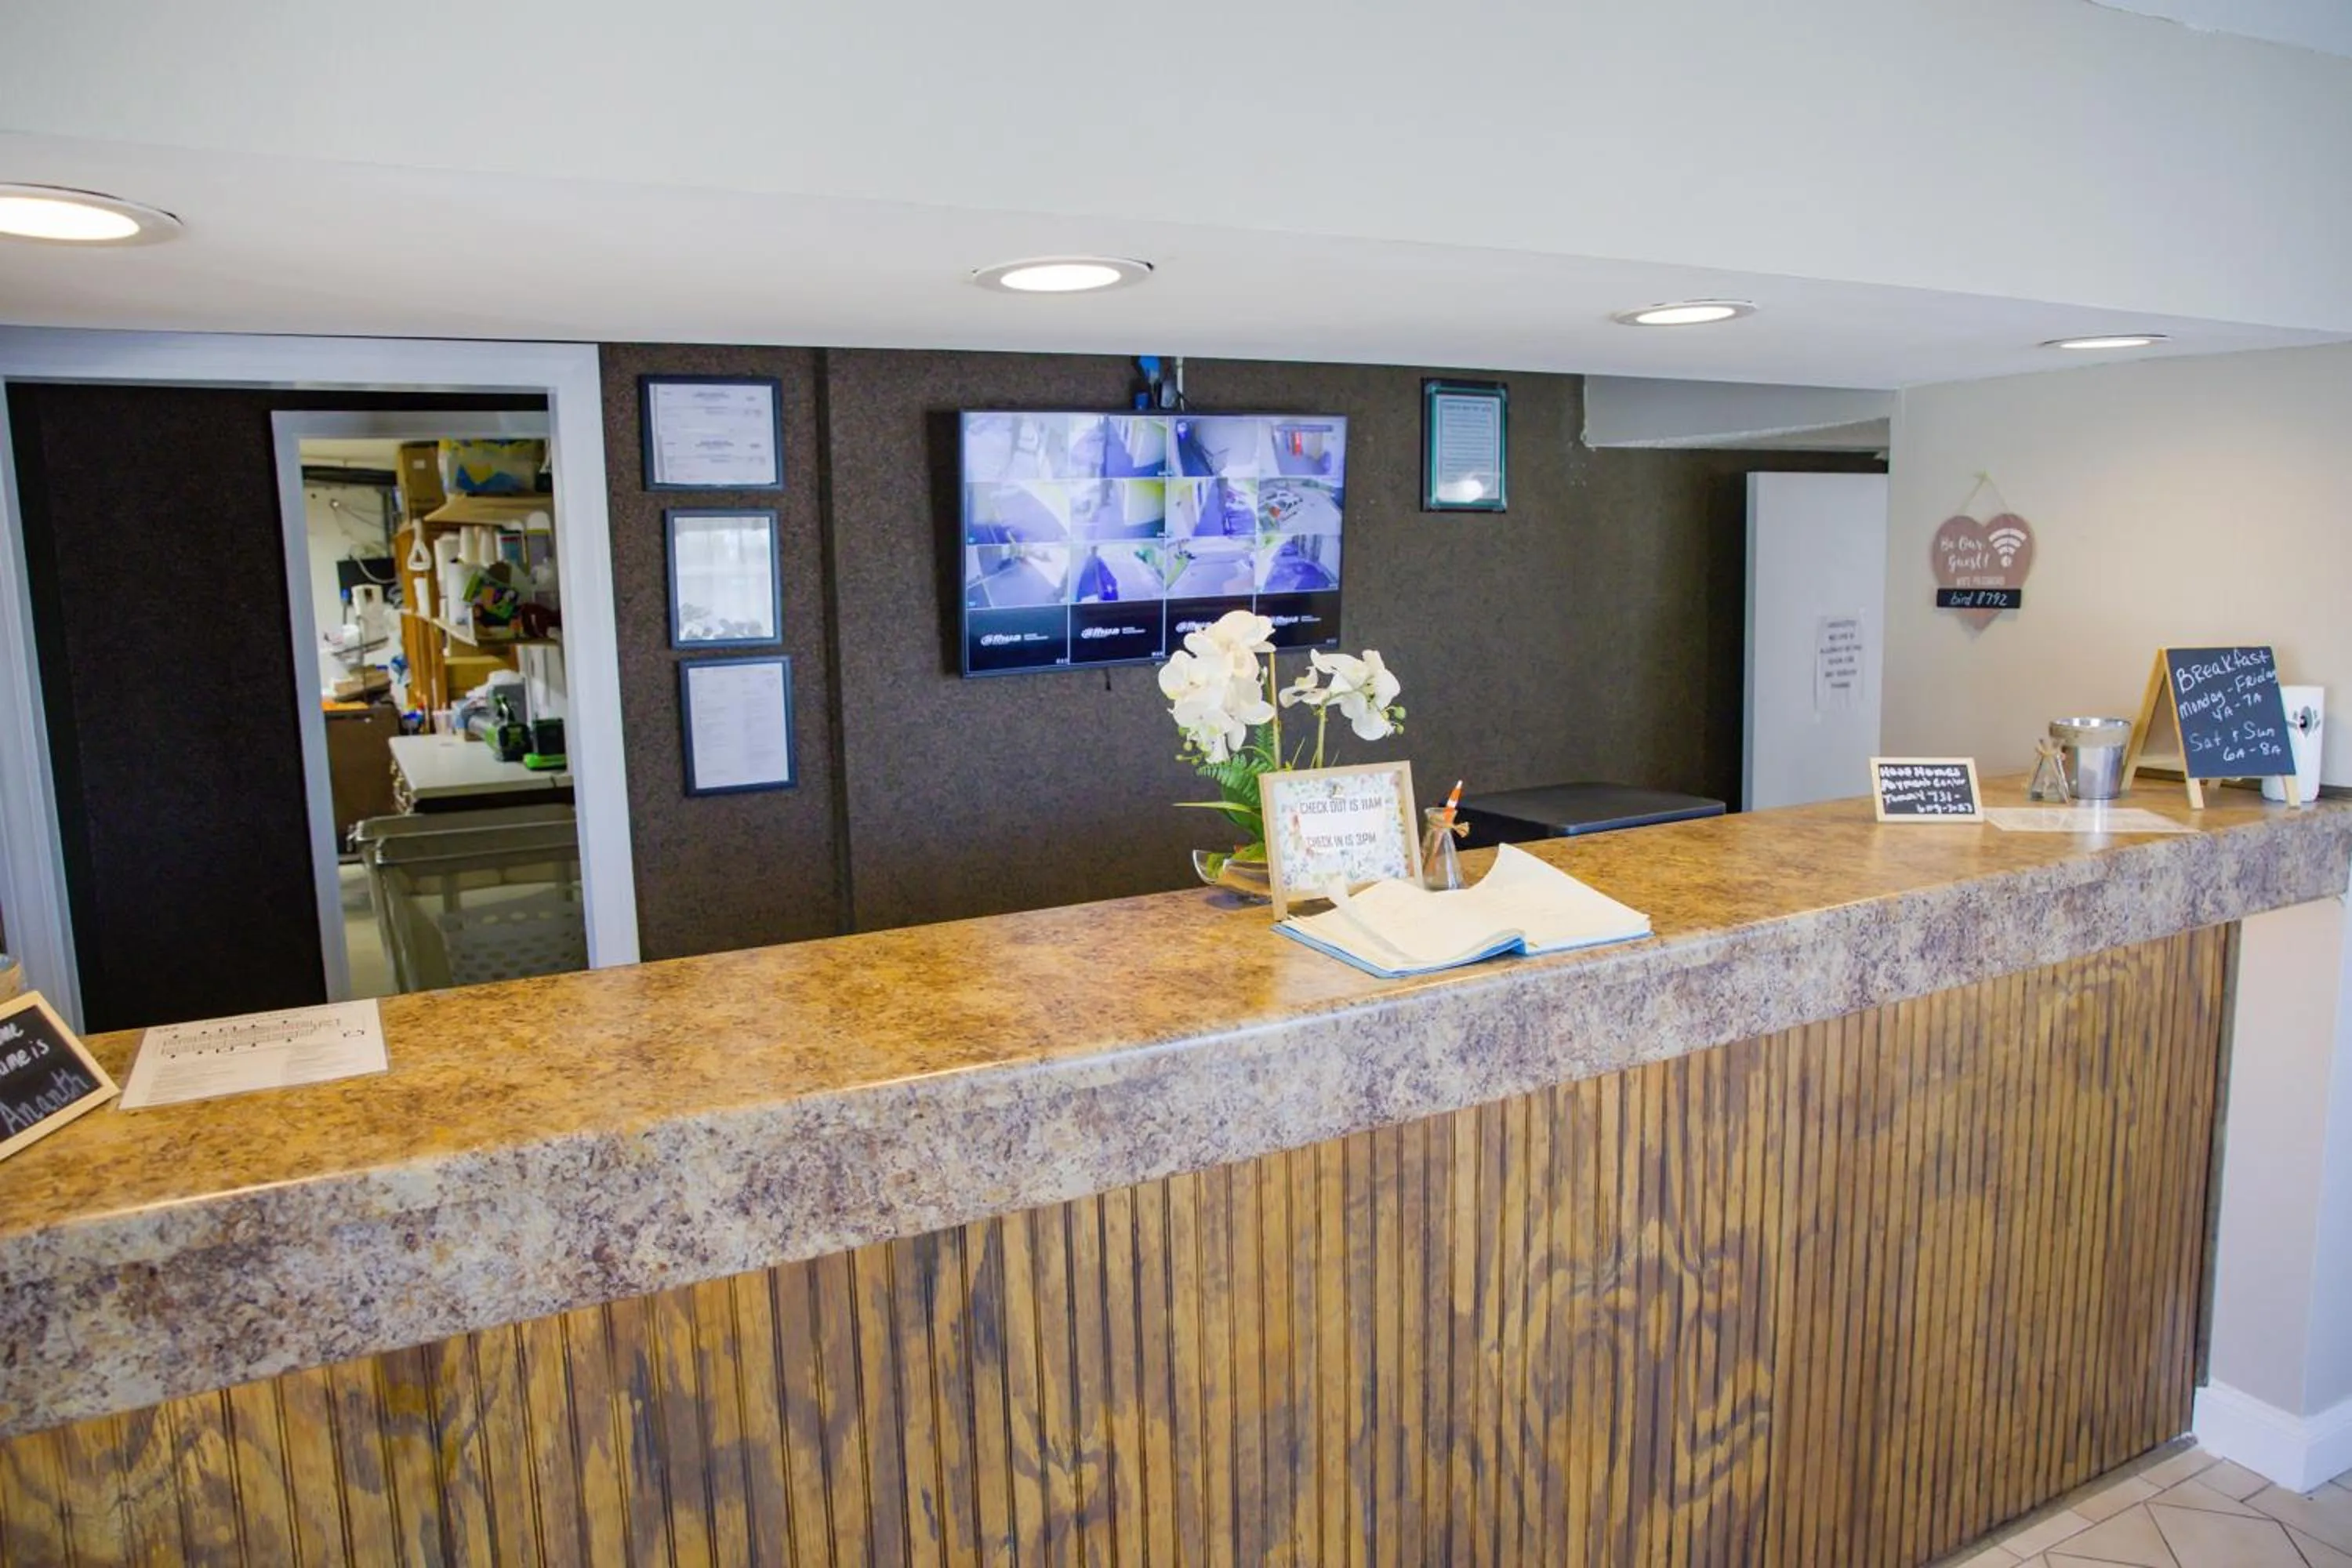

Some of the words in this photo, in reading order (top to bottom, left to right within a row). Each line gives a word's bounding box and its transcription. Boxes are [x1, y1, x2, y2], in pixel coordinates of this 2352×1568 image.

[2189, 729, 2222, 752] Sat
[2243, 721, 2275, 739] Sun
[1299, 800, 1329, 815] CHECK
[1349, 799, 1359, 811] IS
[1306, 835, 1333, 848] CHECK
[1334, 834, 1344, 848] IN
[1345, 834, 1354, 847] IS
[1356, 832, 1377, 846] 3PM
[0, 1049, 31, 1076] ame
[28, 1038, 50, 1059] is
